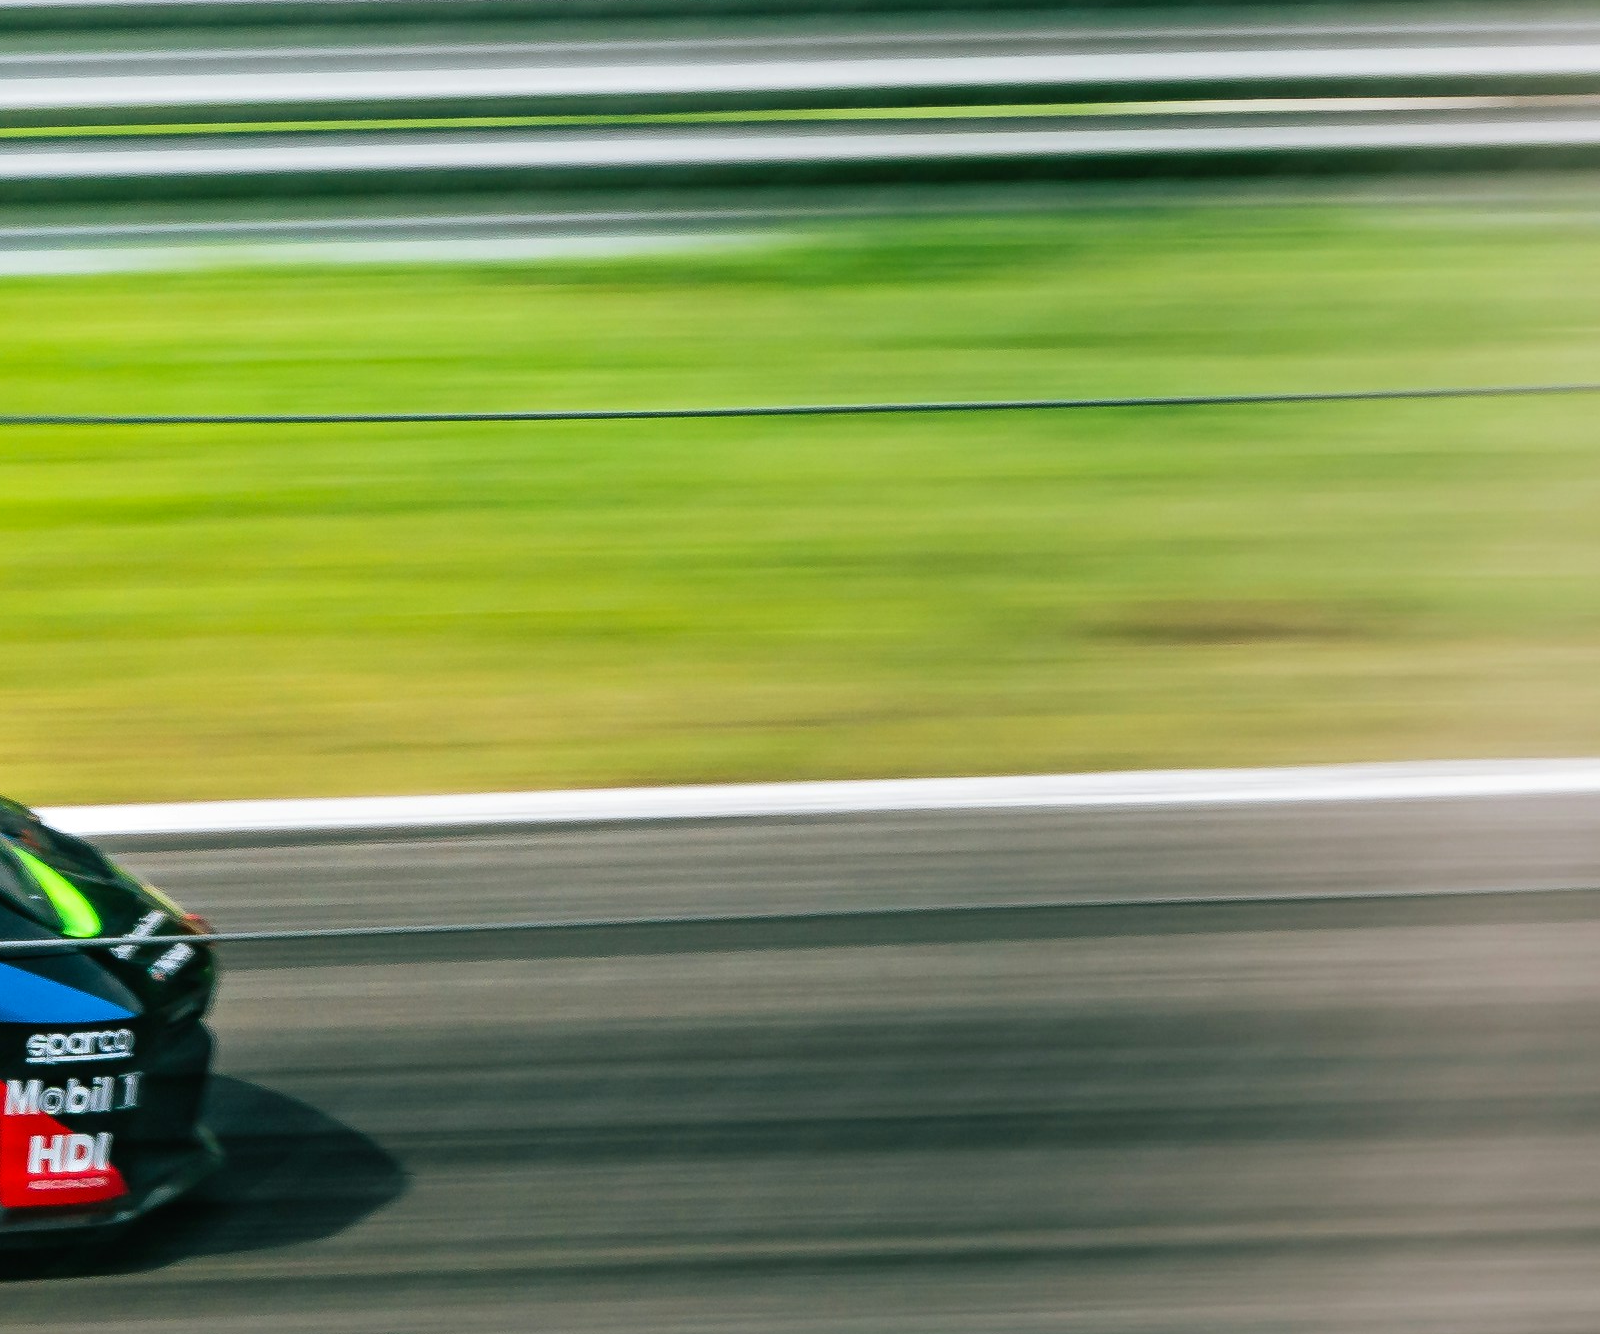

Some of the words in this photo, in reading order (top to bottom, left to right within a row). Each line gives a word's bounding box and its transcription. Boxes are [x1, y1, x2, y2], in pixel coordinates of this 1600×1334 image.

[27, 1028, 136, 1064] sparco
[3, 1076, 115, 1116] Mobil
[27, 1131, 114, 1175] HDI
